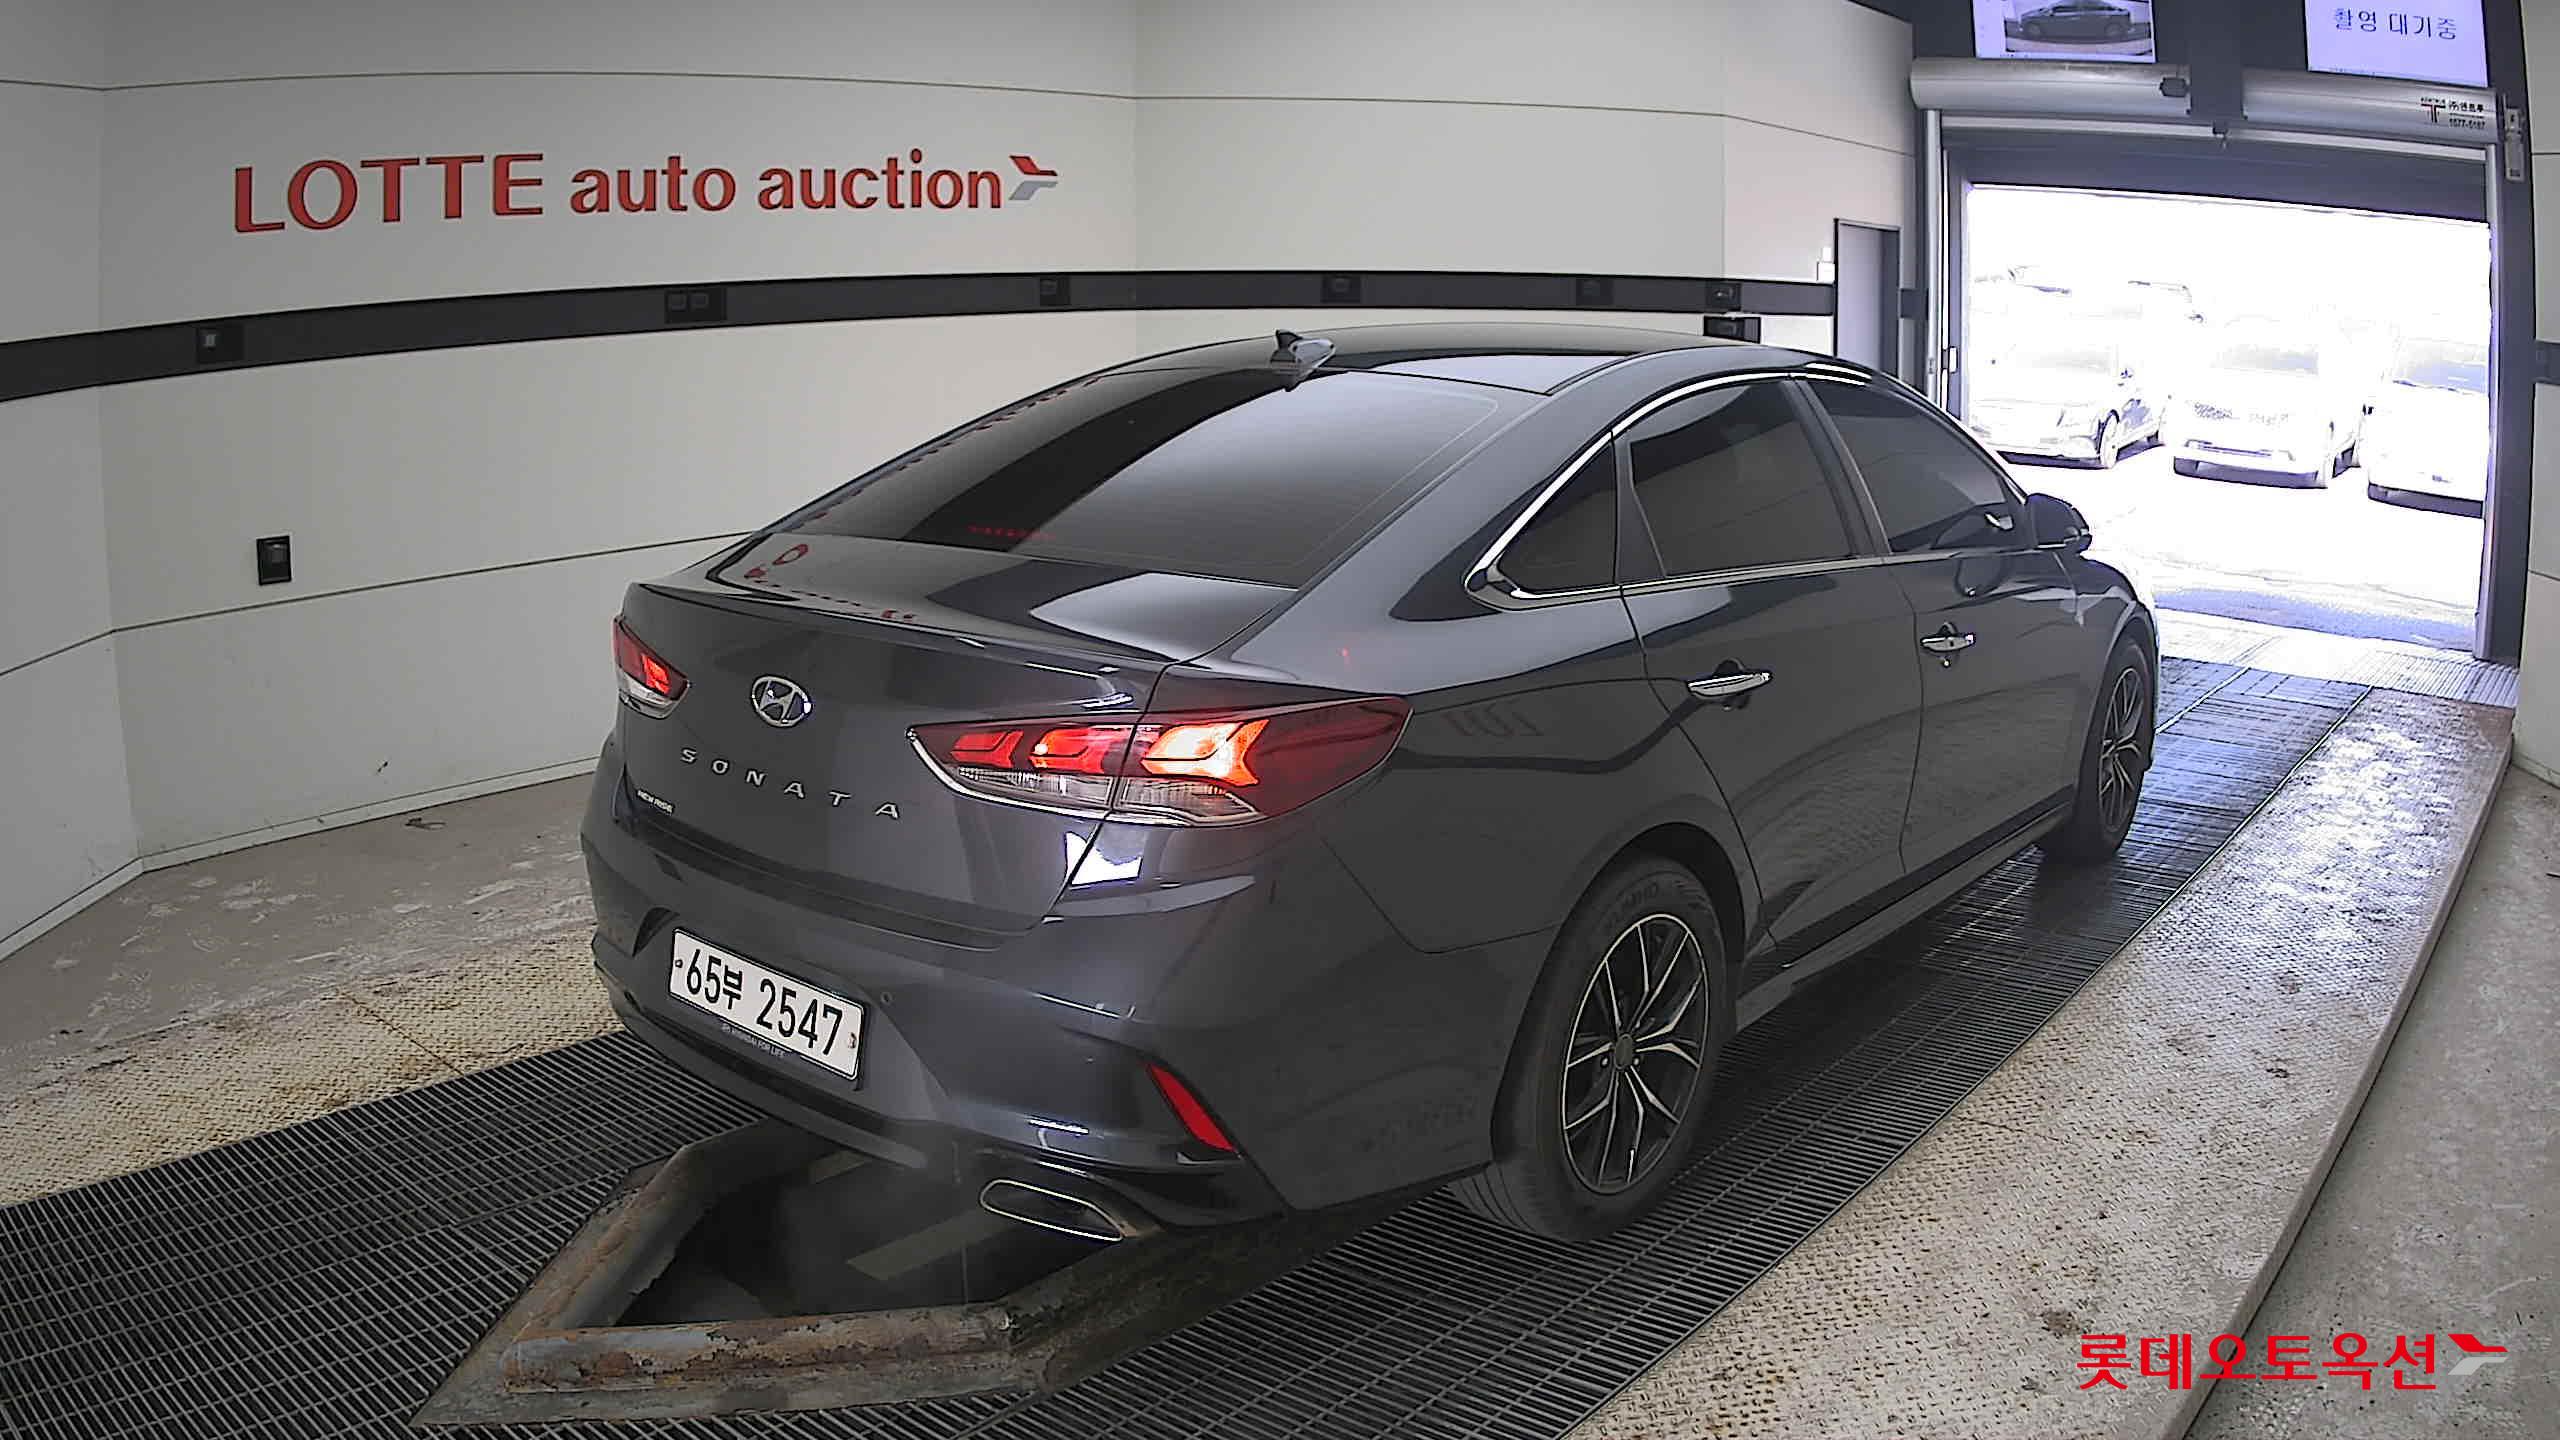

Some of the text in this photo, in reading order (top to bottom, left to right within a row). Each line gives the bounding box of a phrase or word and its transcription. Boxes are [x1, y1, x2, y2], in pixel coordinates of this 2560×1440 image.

[2389, 13, 2457, 40] 대기중
[234, 148, 1003, 233] LOTTE auto auction
[681, 749, 899, 819] SONATA
[687, 949, 843, 1056] 65부 2547
